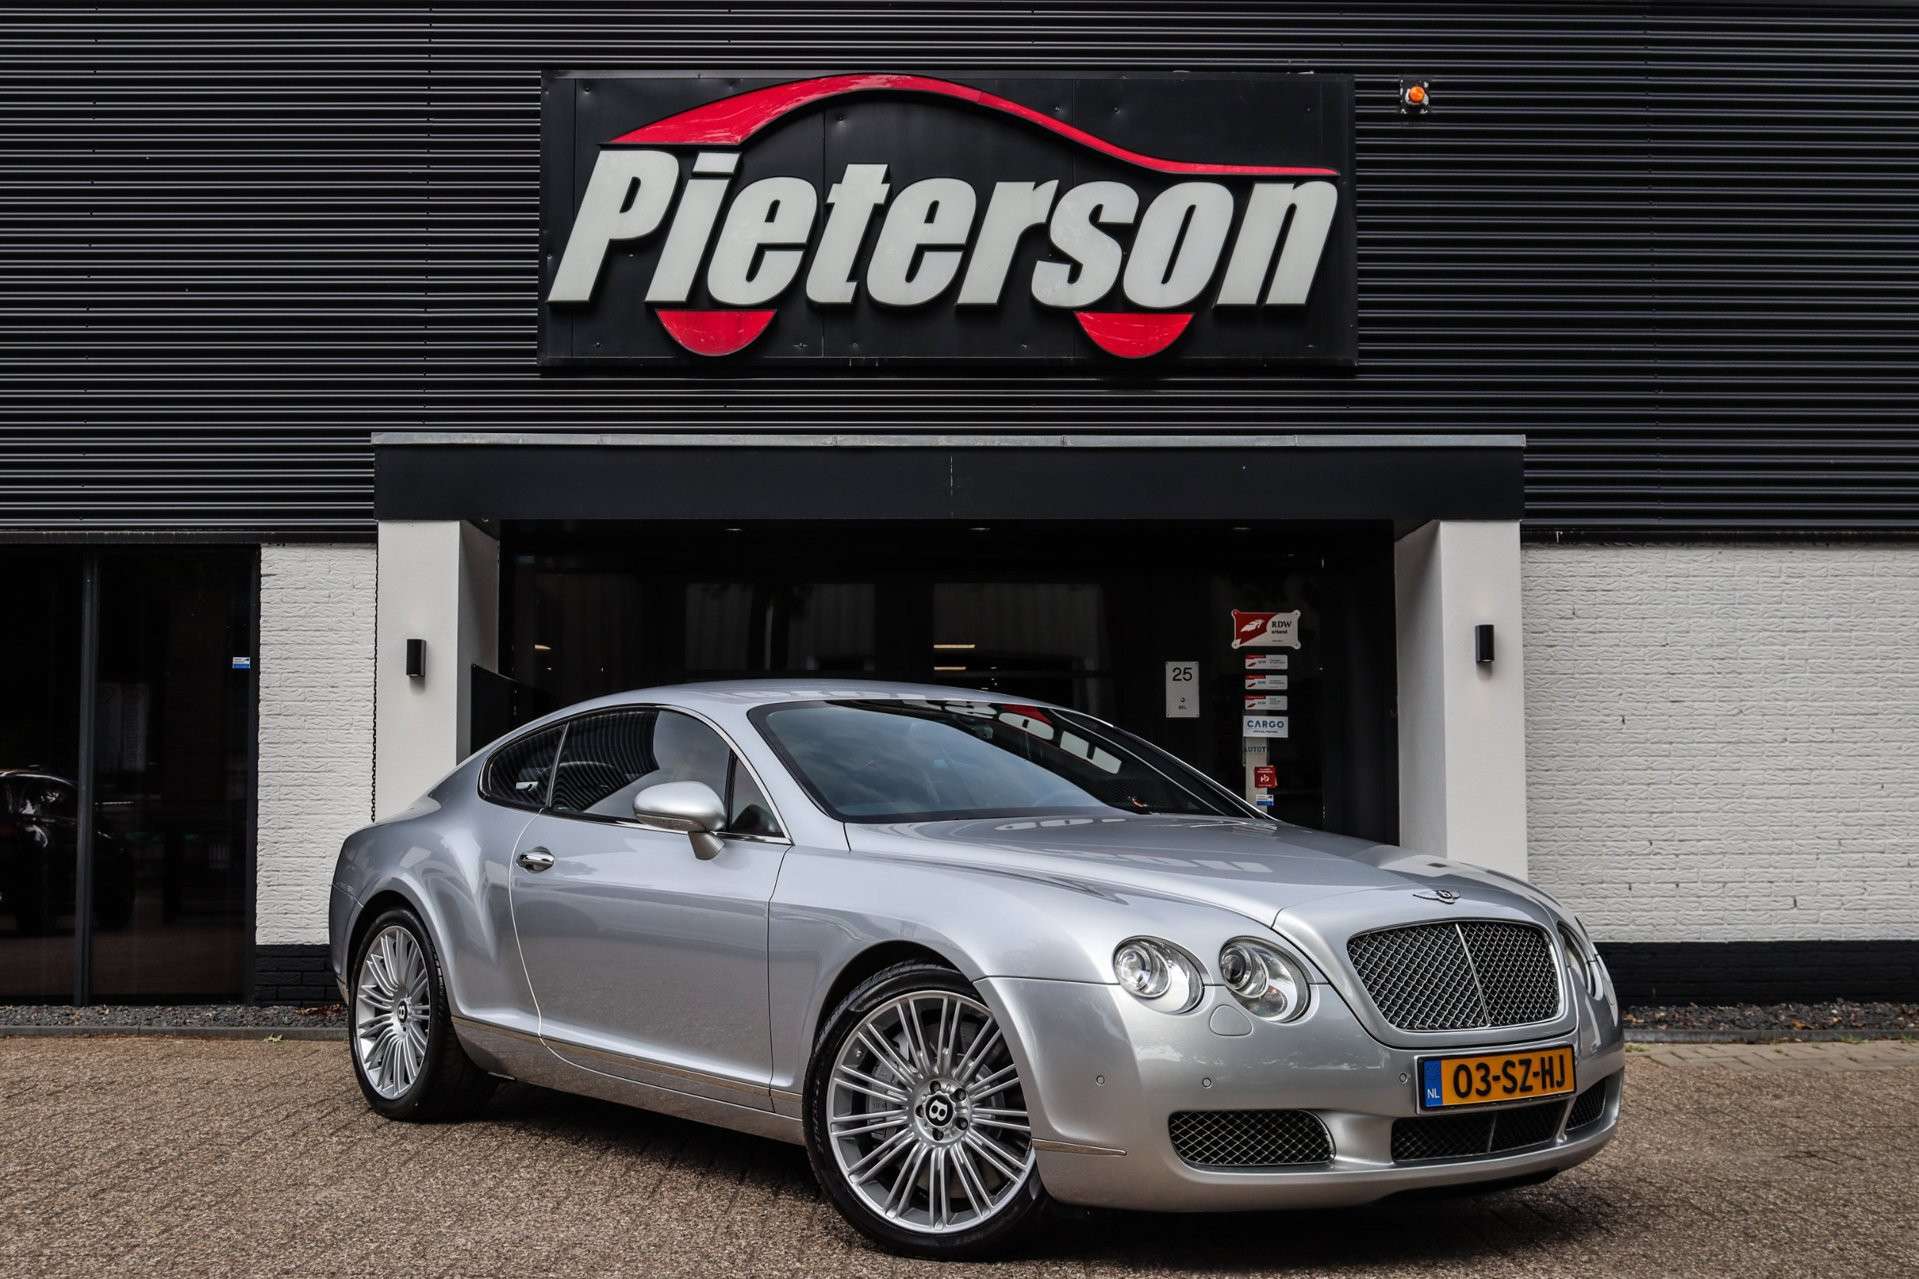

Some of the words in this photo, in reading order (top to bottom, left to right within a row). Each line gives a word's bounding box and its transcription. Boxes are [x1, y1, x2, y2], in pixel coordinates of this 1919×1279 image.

[548, 149, 1338, 307] Pieterson
[1271, 620, 1292, 628] RDW
[1172, 667, 1193, 682] 25
[1247, 720, 1285, 729] CARGO
[1453, 1054, 1566, 1098] 03-SZ-HJ
[1427, 1088, 1440, 1099] NL
